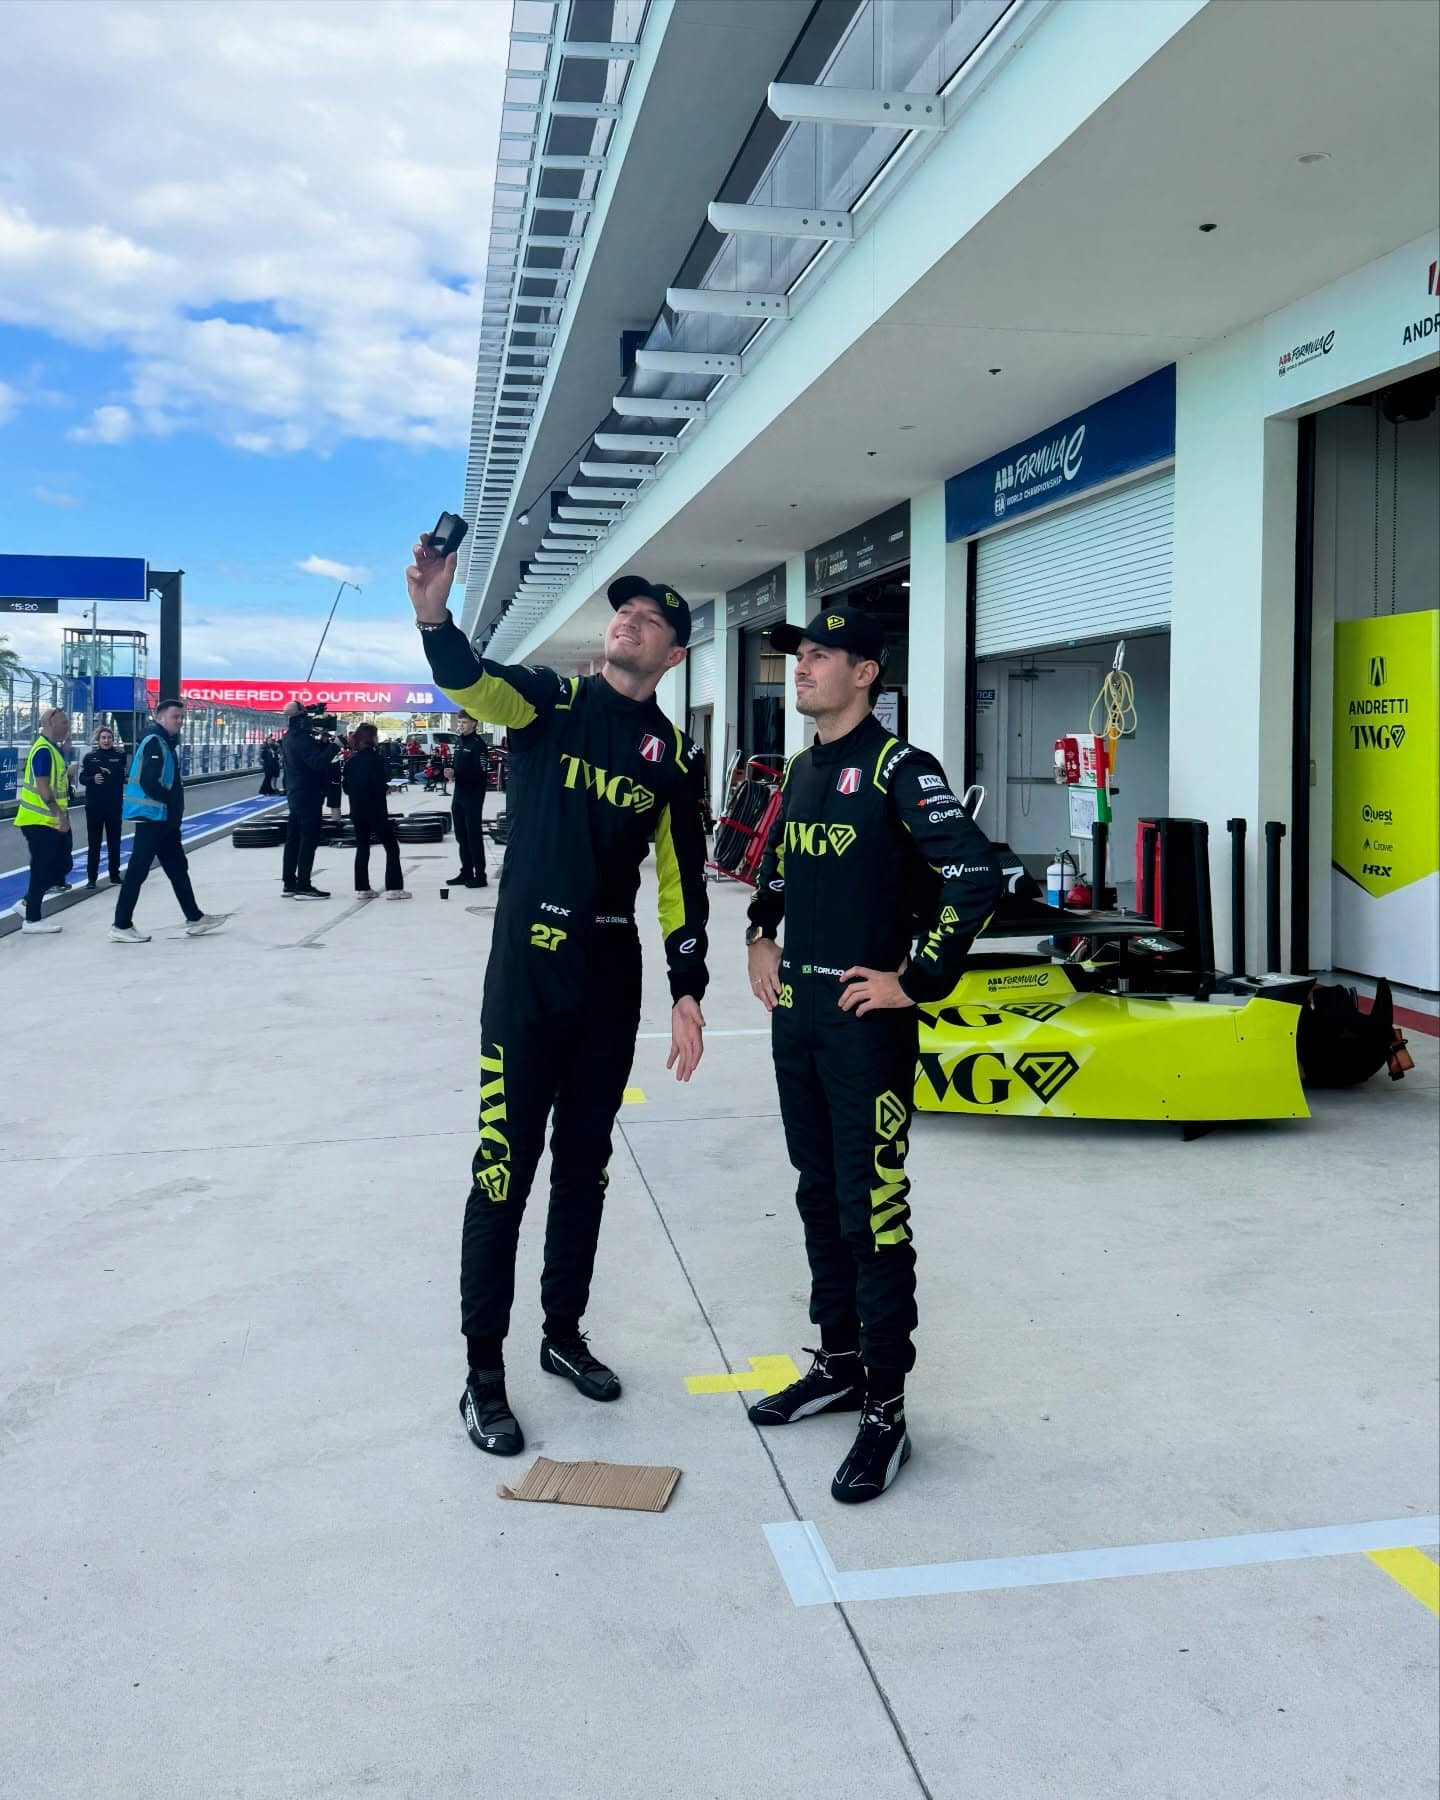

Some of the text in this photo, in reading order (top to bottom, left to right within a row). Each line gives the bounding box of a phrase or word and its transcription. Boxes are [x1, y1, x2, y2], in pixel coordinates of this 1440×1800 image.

[994, 464, 1014, 493] ABB
[1013, 434, 1066, 488] FORMULA
[288, 691, 313, 703] TO
[316, 691, 391, 703] OUTRUN
[405, 692, 434, 704] ABB
[1349, 698, 1409, 715] ANDRETTI
[1350, 725, 1390, 749] TWG
[560, 753, 633, 807] TWG
[1362, 804, 1393, 823] Quest
[1362, 863, 1393, 878] HRX
[540, 902, 572, 917] HRX
[530, 923, 567, 952] 27
[987, 978, 1002, 986] ABB
[1002, 974, 1038, 985] FORMULA
[480, 1043, 511, 1162] TWG
[870, 1141, 911, 1252] TWG
